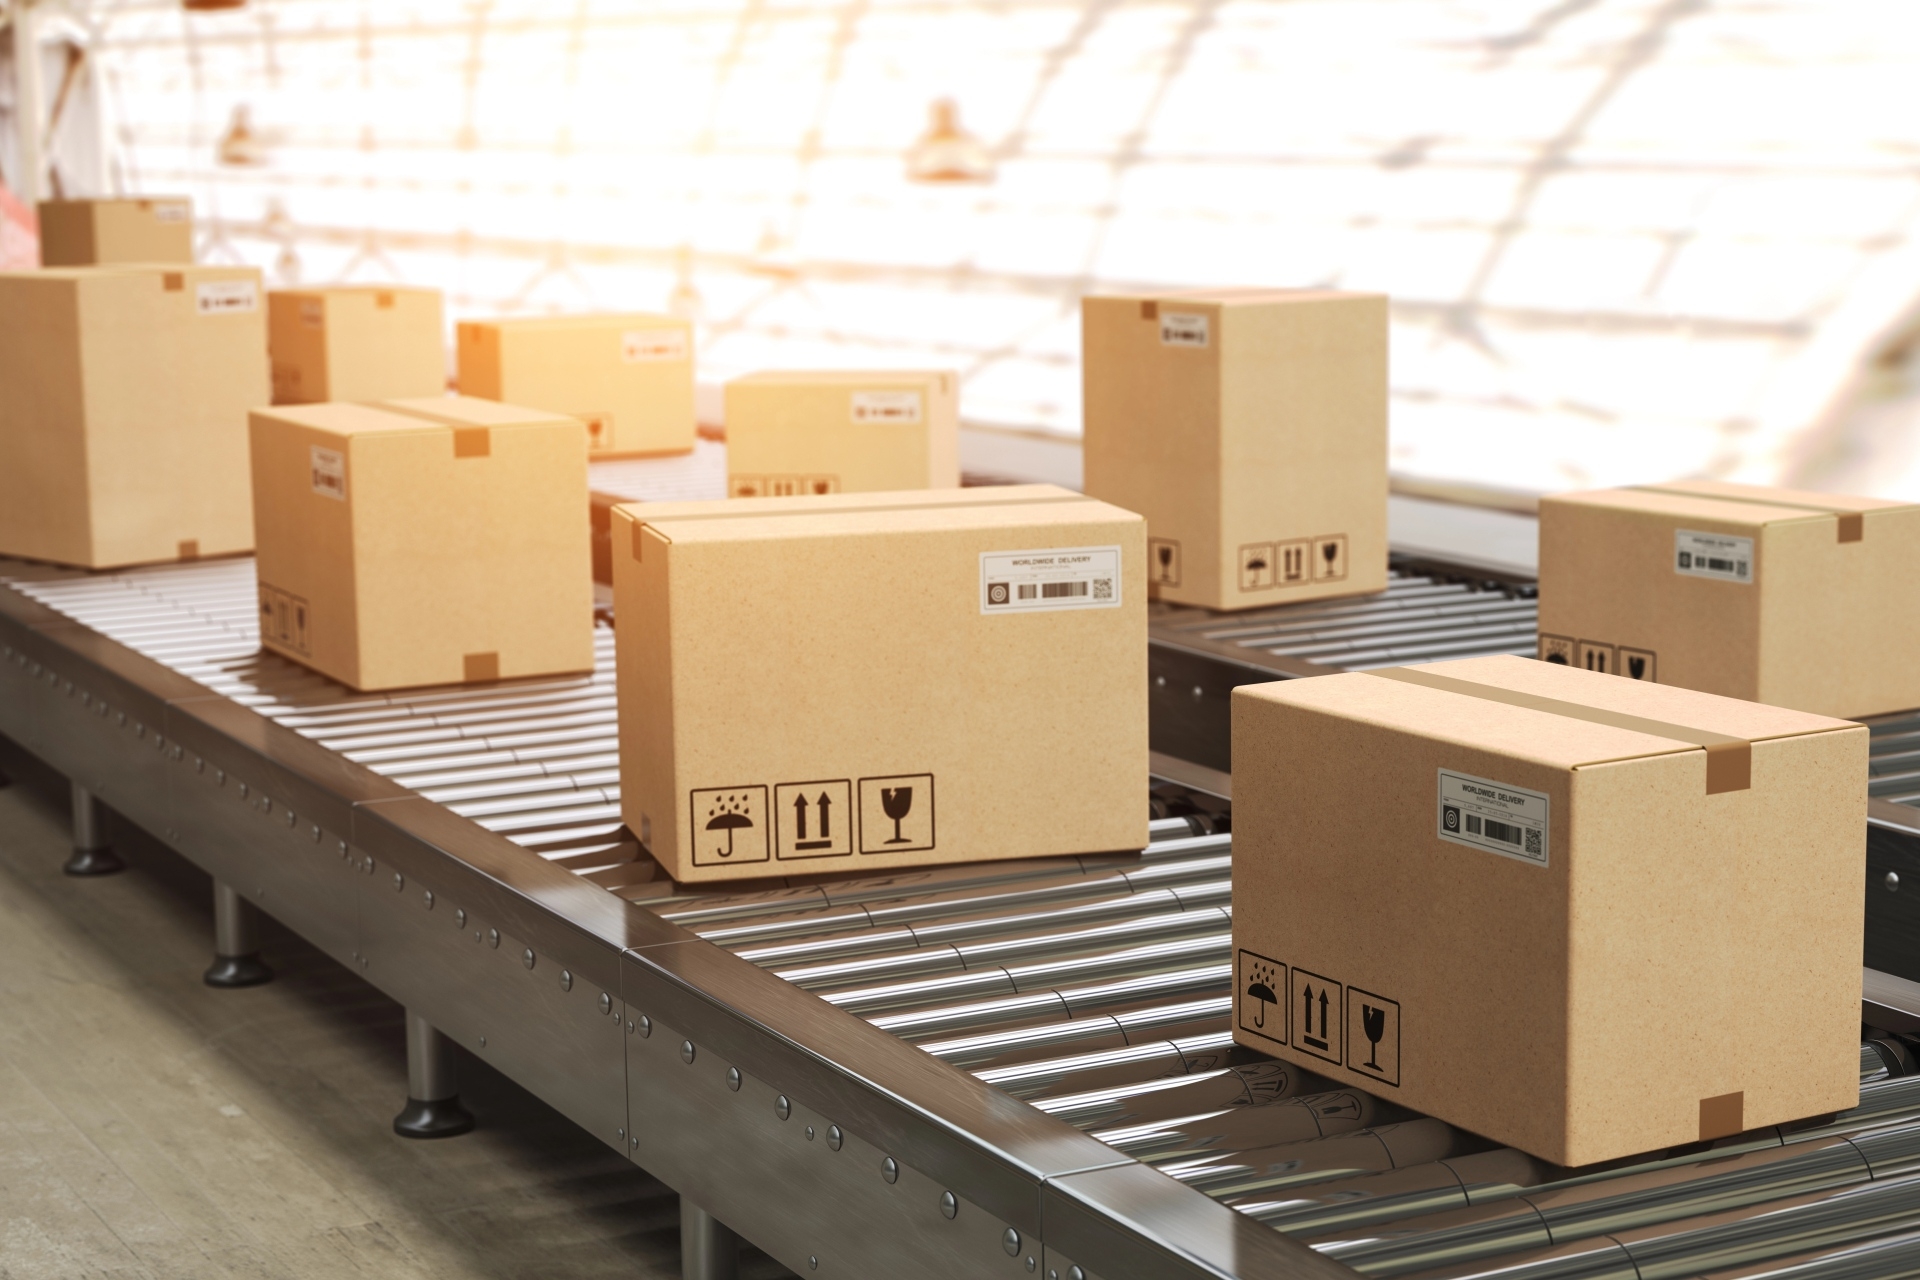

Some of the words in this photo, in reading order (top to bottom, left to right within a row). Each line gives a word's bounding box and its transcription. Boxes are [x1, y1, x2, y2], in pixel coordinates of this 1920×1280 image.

[1012, 558, 1054, 566] WORLDWIDE
[1058, 556, 1091, 564] DELIVERY
[1462, 784, 1496, 799] WORLDWIDE
[1498, 793, 1526, 806] DELIVERY
[1476, 796, 1509, 808] INTERNATIONAL
